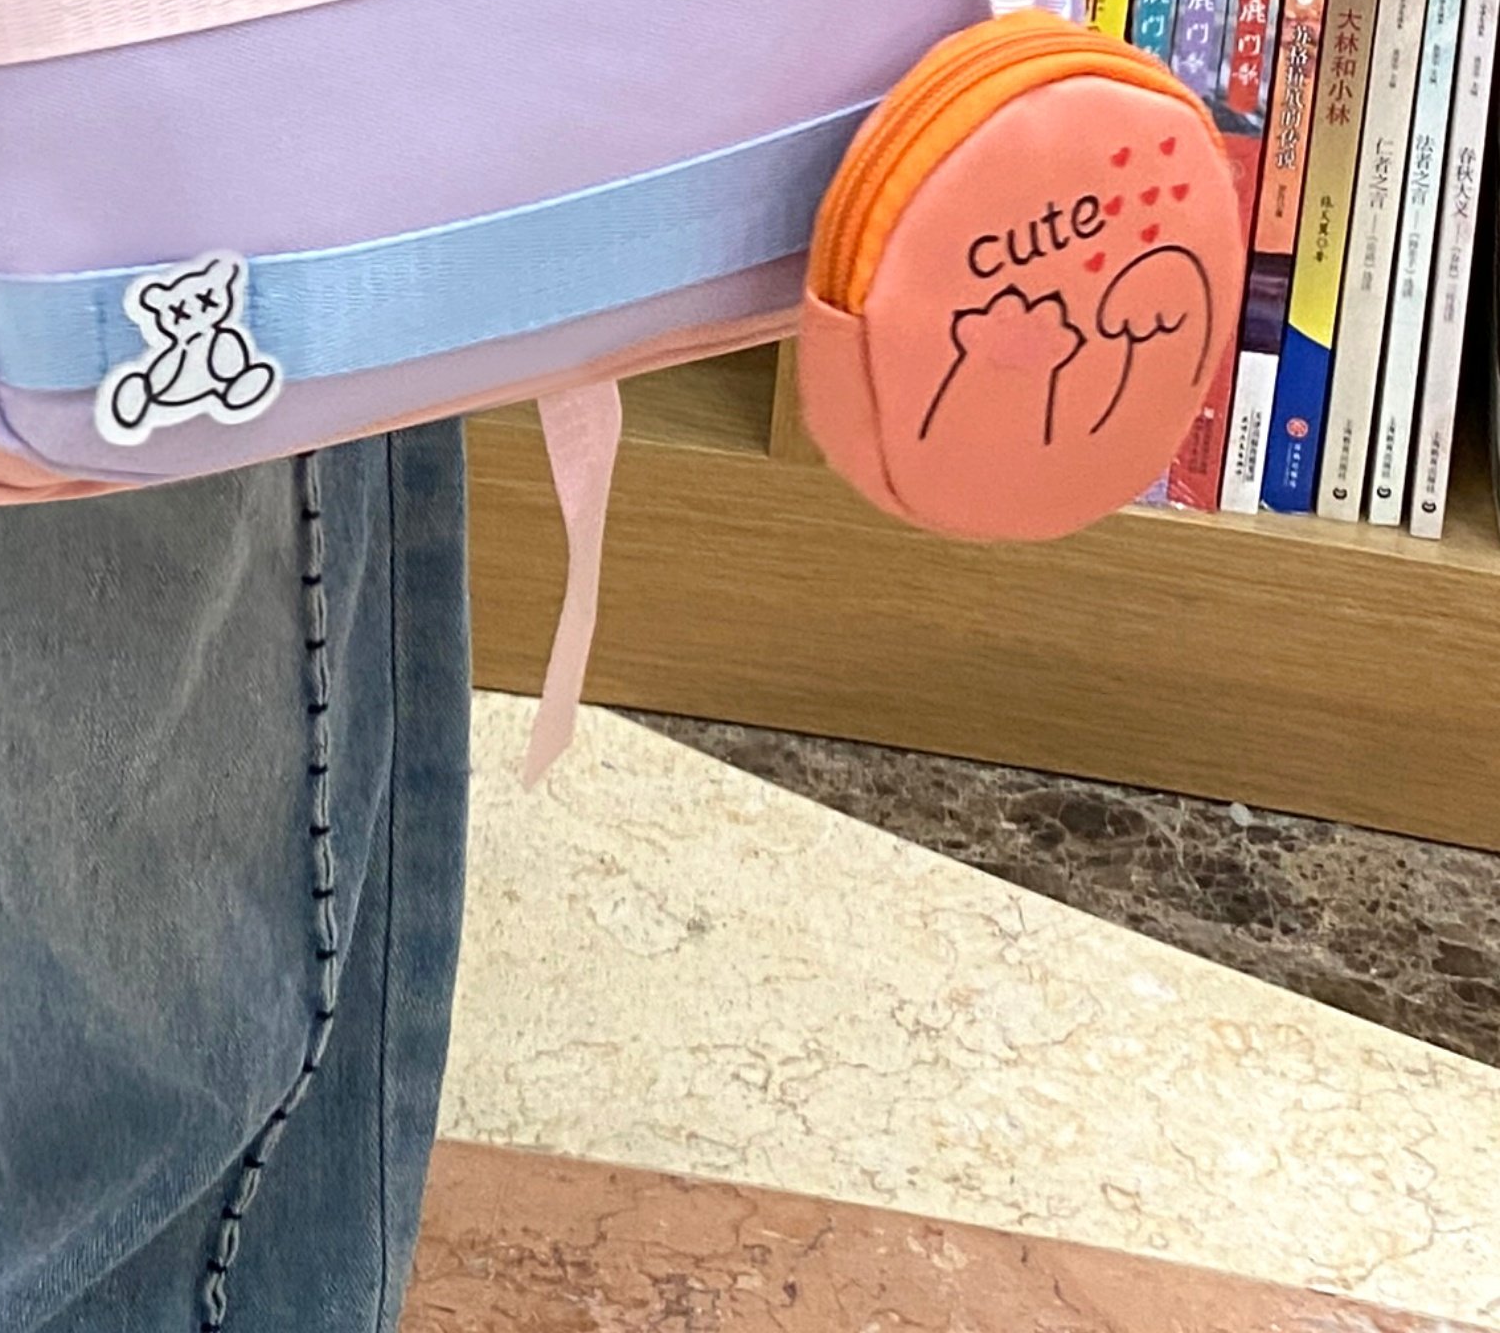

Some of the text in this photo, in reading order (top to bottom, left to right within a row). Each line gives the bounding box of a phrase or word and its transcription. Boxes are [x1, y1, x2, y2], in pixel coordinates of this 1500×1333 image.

[1325, 7, 1363, 127] 大林和小林
[968, 194, 1107, 279] cute
